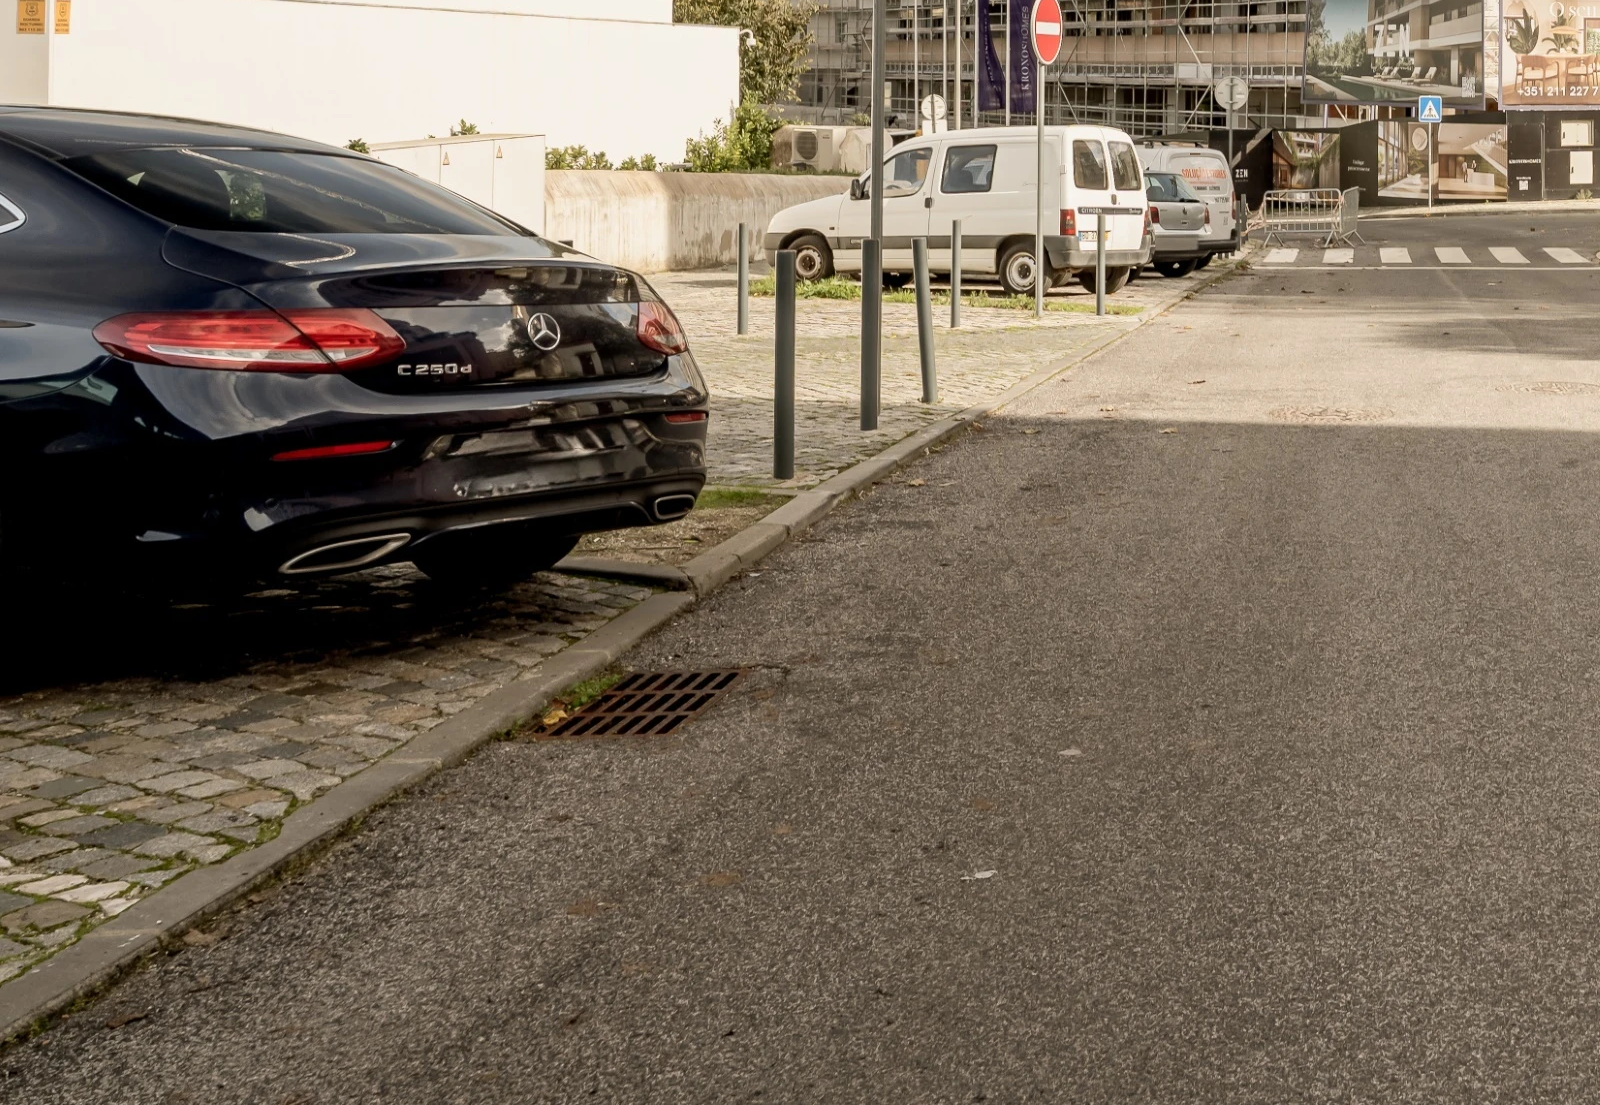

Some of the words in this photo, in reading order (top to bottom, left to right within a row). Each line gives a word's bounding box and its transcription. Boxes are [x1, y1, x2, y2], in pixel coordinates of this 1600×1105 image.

[1549, 1, 1565, 18] O
[1568, 5, 1598, 18] seu
[1373, 24, 1410, 58] ZEN
[1517, 85, 1544, 97] +351
[1547, 85, 1567, 97] 211
[1569, 85, 1590, 97] 227
[1235, 169, 1249, 179] ZEN
[397, 364, 412, 376] C
